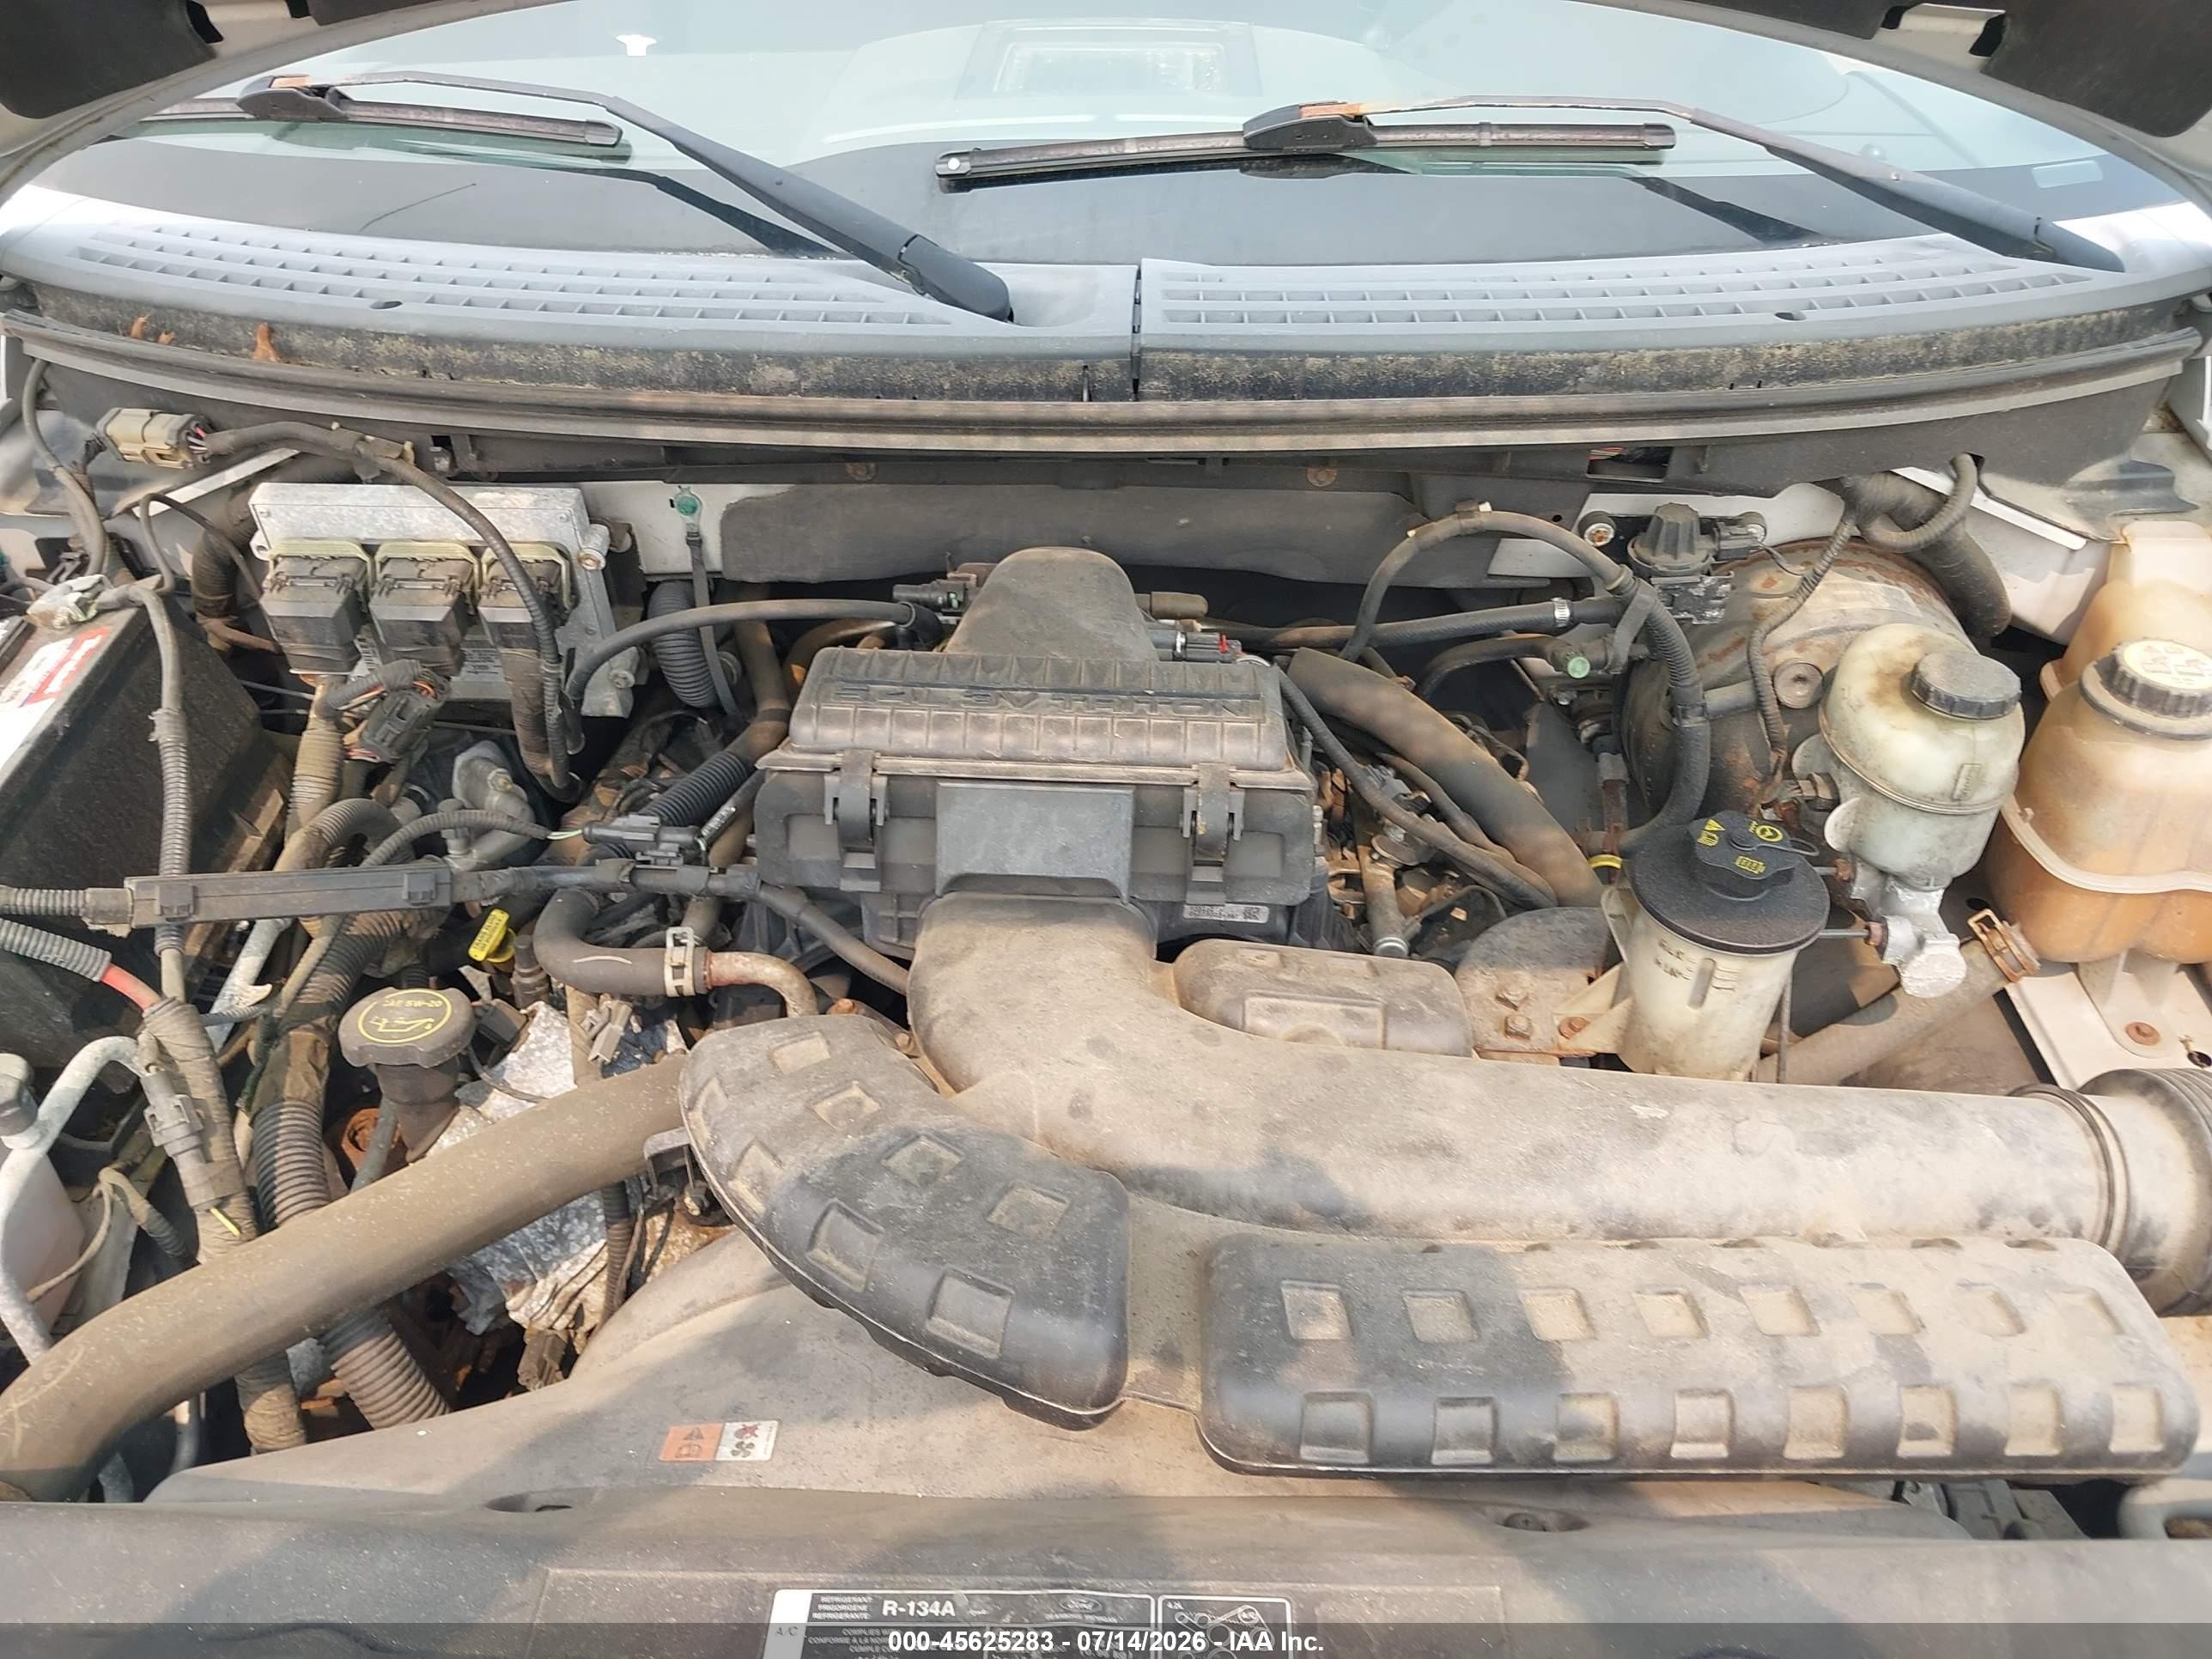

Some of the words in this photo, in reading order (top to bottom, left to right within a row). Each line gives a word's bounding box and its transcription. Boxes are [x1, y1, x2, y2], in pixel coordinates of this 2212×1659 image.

[1051, 691, 1254, 718] TRITON
[404, 999, 443, 1008] 5W-20
[882, 1600, 956, 1617] R-134A
